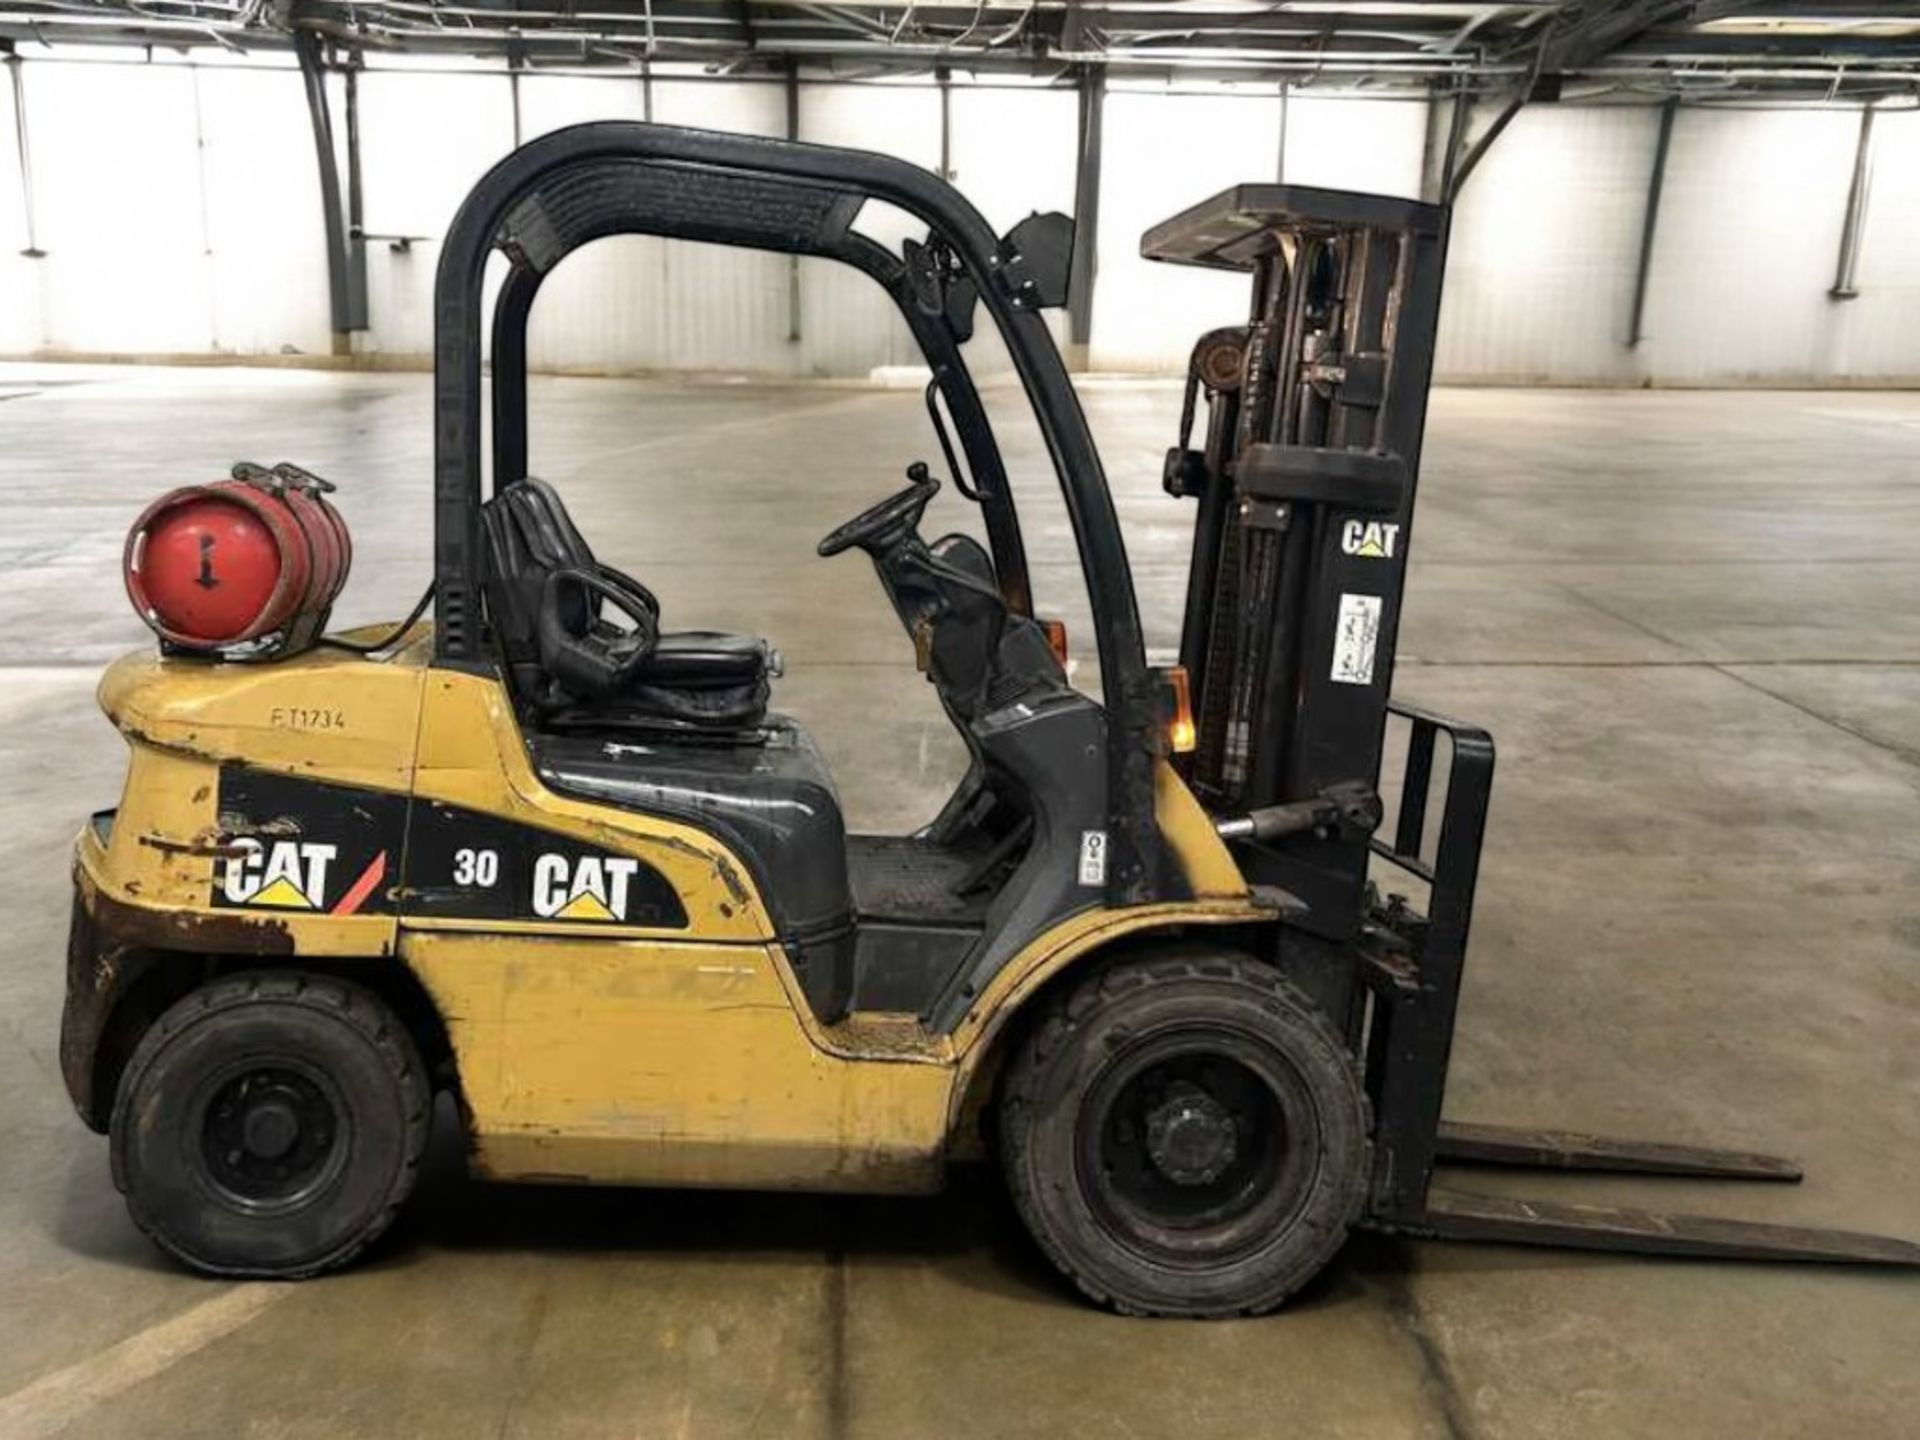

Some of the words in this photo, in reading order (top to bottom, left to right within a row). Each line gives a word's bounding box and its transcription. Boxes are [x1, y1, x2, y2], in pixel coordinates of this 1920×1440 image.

[1342, 519, 1399, 558] CAT
[223, 837, 337, 908] CAT
[453, 848, 498, 887] 30
[533, 853, 638, 921] CAT
